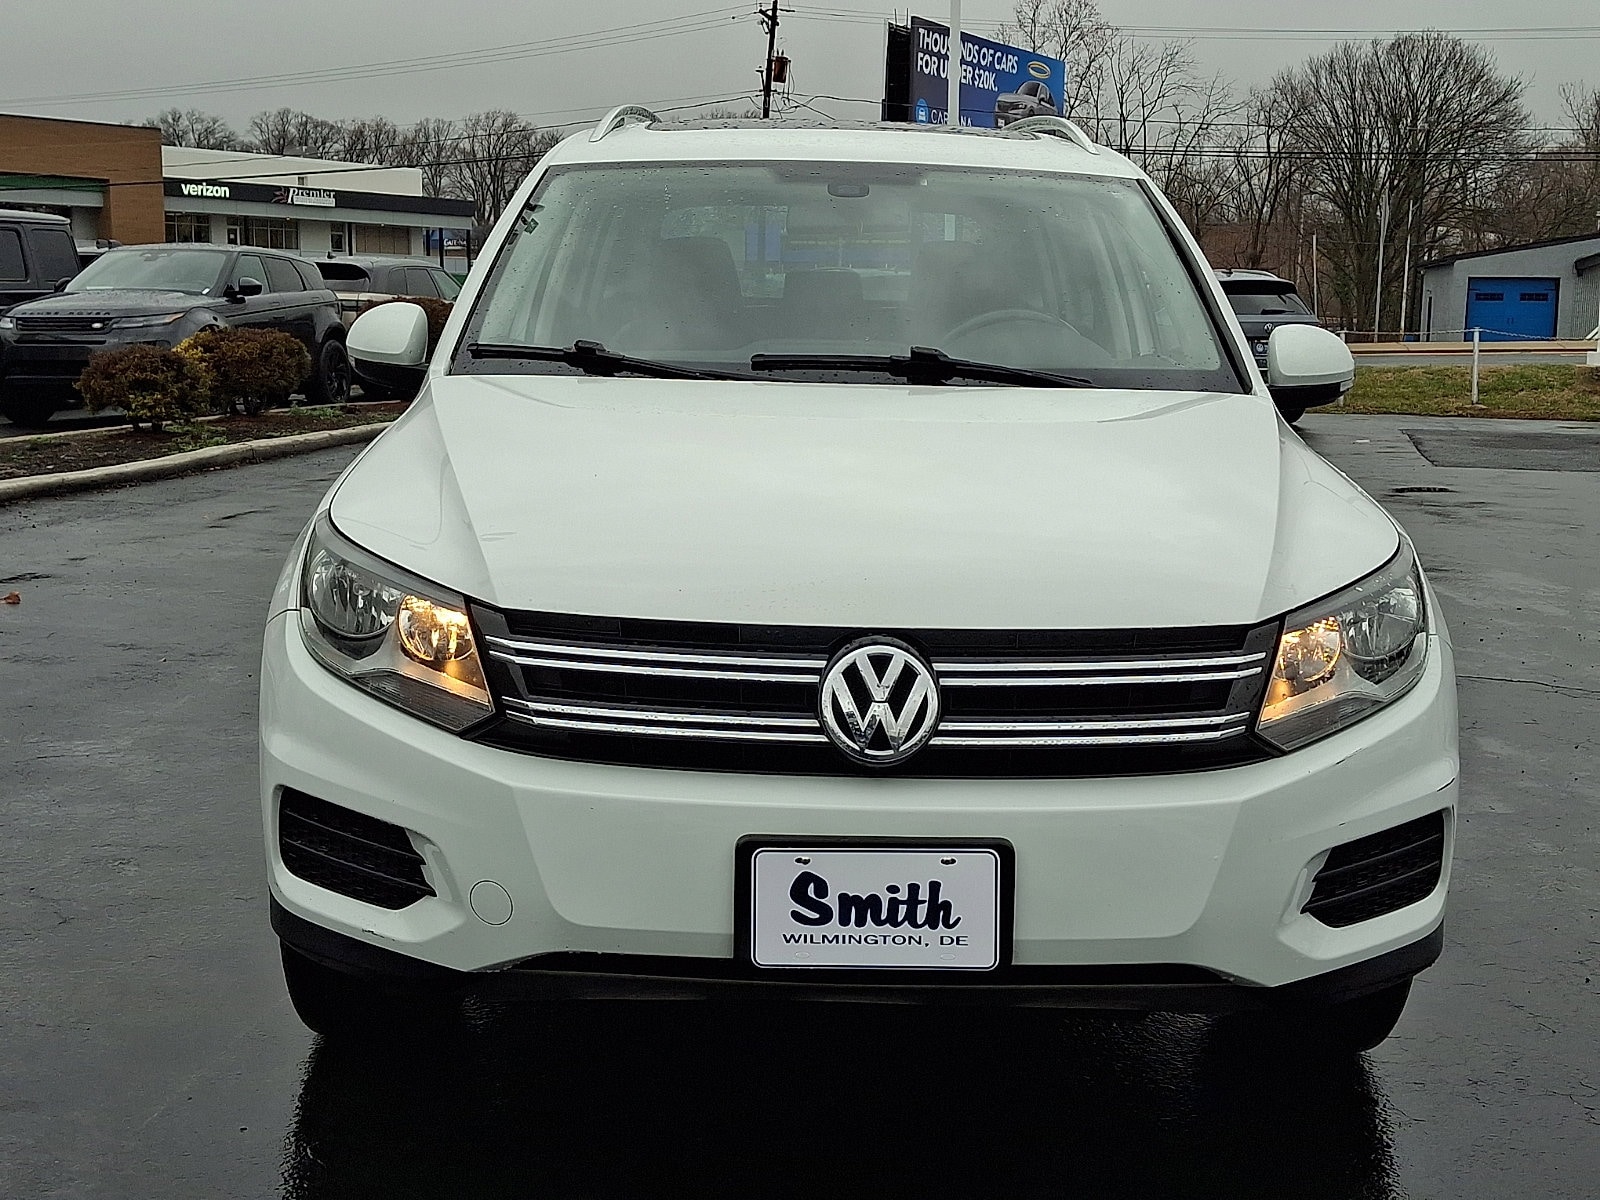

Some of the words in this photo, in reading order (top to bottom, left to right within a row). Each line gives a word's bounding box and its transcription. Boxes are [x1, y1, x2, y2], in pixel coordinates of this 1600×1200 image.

[918, 28, 979, 64] THOUNDS
[980, 47, 994, 67] OF
[994, 51, 1018, 74] CARS
[917, 52, 938, 76] FOR
[939, 56, 973, 86] UER
[974, 66, 998, 92] $20K.
[931, 109, 972, 127] CARNA
[180, 182, 230, 198] verizon
[287, 187, 336, 204] Premier
[789, 870, 962, 930] Smith
[782, 933, 930, 948] WILMINGTON,
[939, 935, 969, 946] DE
